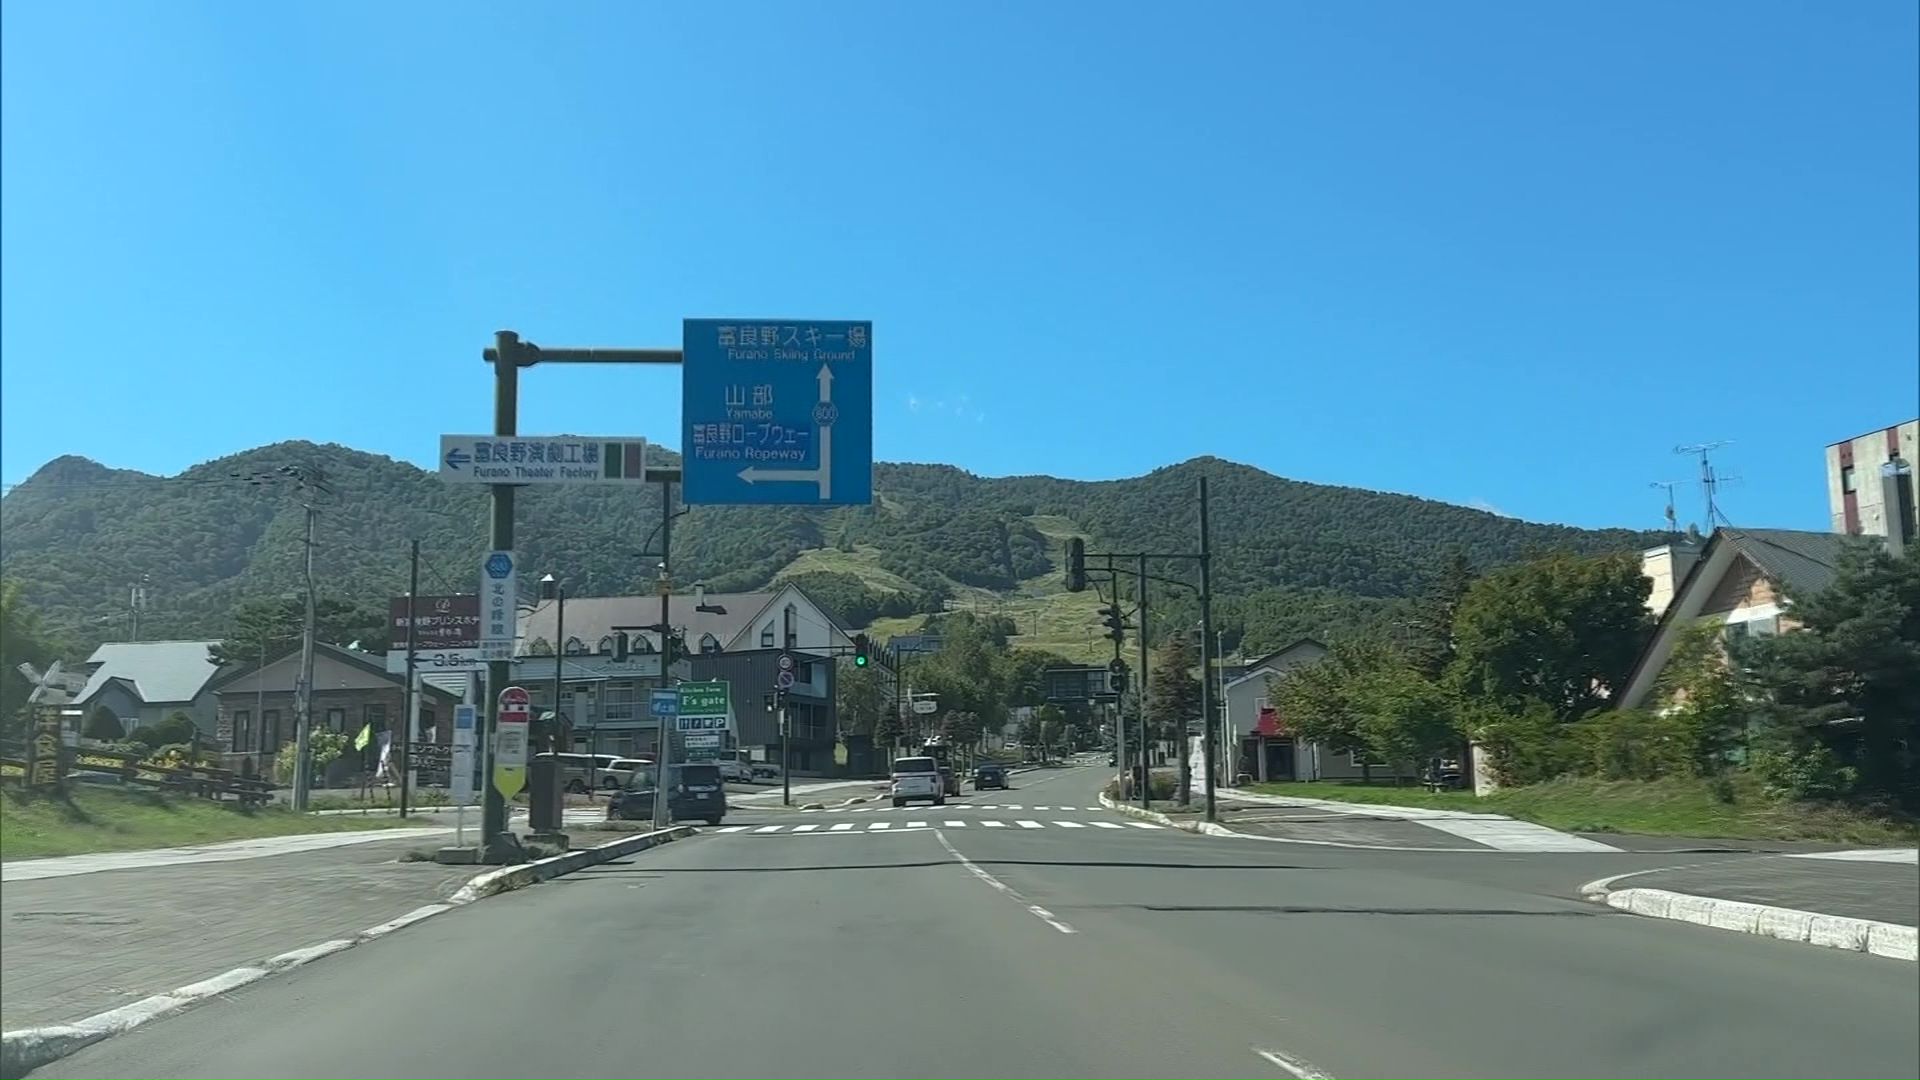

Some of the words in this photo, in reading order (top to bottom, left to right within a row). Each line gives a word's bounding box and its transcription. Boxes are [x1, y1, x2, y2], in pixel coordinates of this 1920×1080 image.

[717, 326, 867, 348] 富良野スキー場
[727, 349, 769, 360] Furano
[774, 349, 808, 361] Skiing
[813, 349, 856, 361] Ground
[725, 384, 774, 406] 山部
[726, 408, 773, 420] Yamabe
[693, 422, 809, 444] 富良野ロープウェー
[473, 441, 600, 464] 富良野演劇工場
[695, 446, 741, 460] Furano
[744, 446, 807, 461] Ropeway
[473, 466, 511, 478] Furano
[515, 466, 555, 478] Theater
[559, 466, 600, 481] Factory
[700, 697, 726, 707] gate
